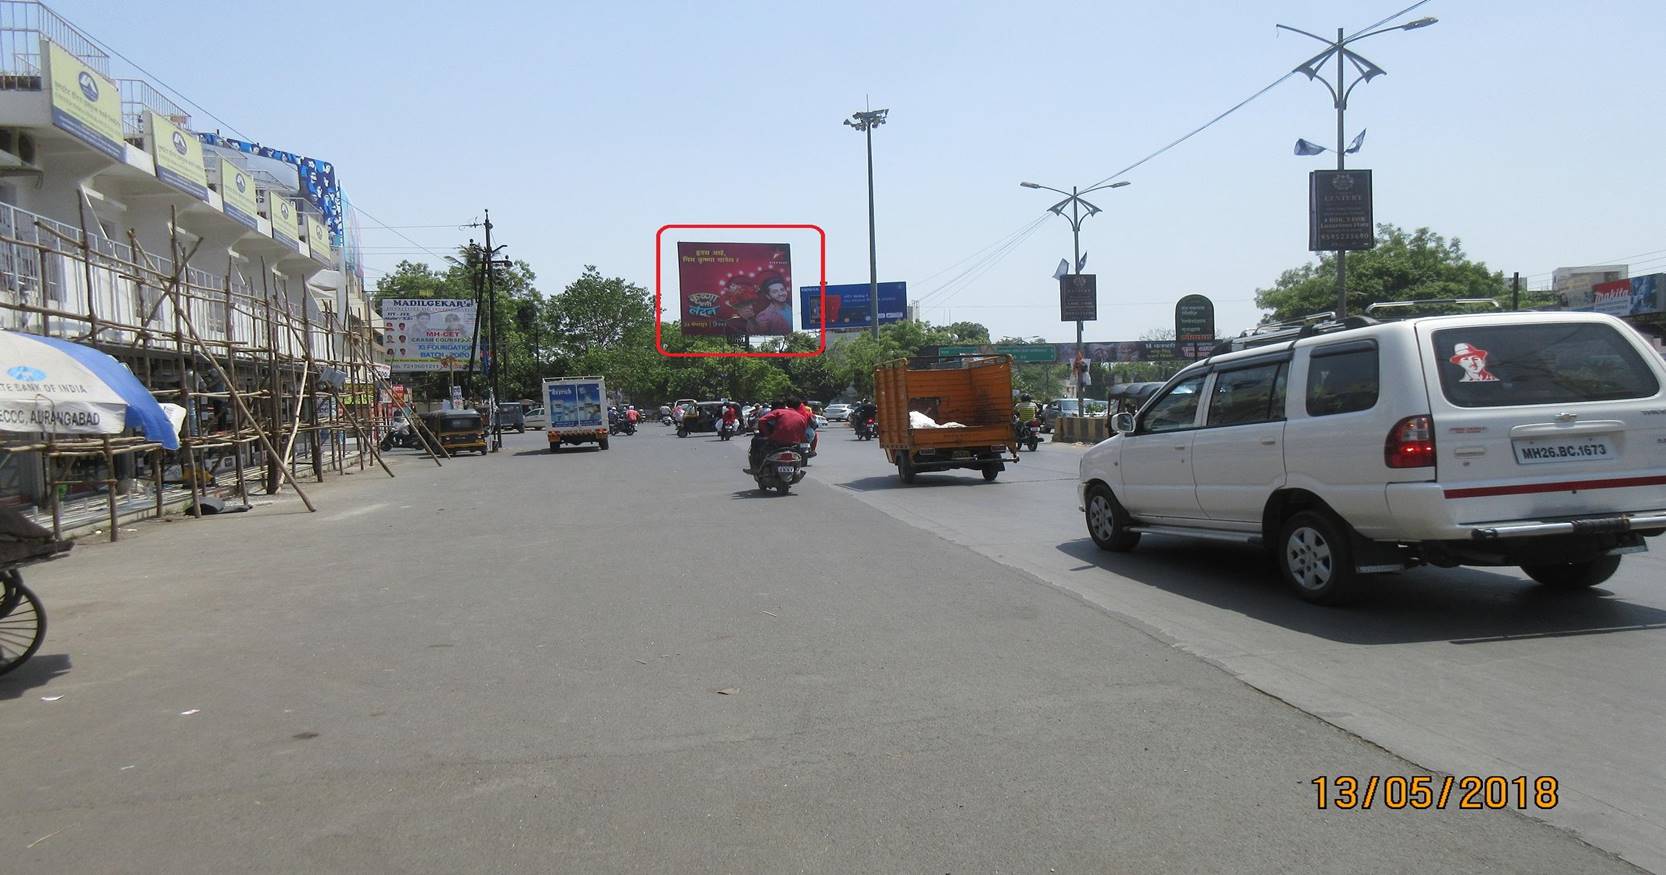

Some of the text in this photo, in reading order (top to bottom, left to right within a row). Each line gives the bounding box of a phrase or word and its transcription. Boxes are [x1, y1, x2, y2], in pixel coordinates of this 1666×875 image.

[15, 384, 42, 393] BANK
[44, 384, 56, 393] OF
[59, 385, 88, 394] INDIA
[30, 408, 101, 427] AURANGABAD
[1522, 443, 1607, 460] MH26.BC.1673
